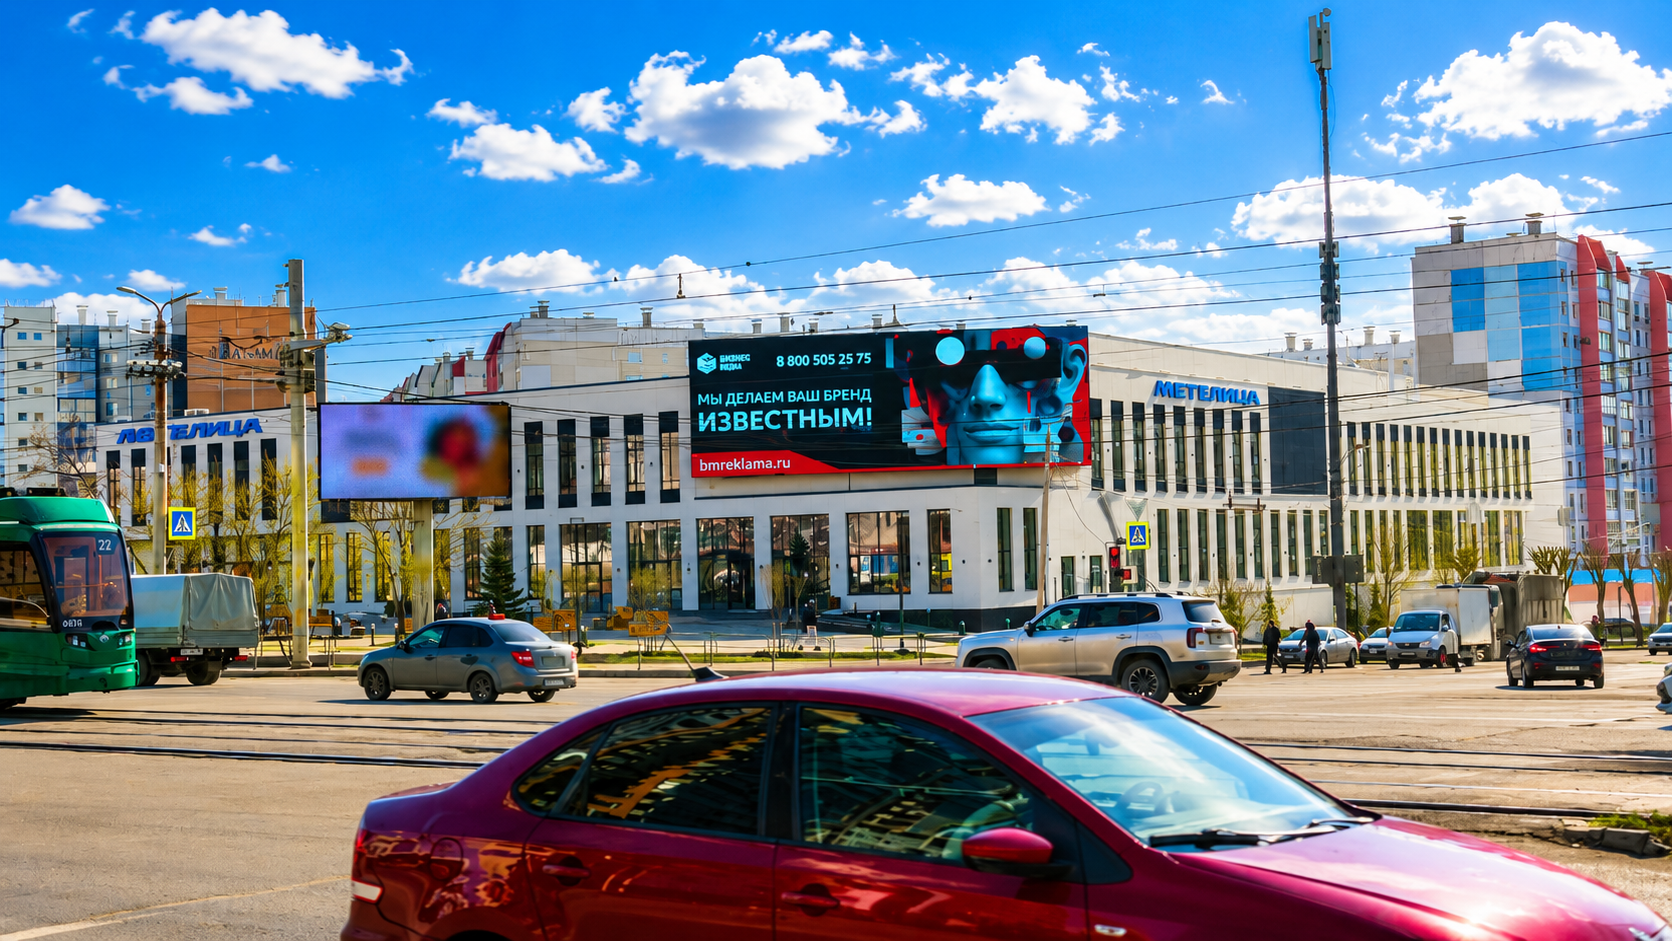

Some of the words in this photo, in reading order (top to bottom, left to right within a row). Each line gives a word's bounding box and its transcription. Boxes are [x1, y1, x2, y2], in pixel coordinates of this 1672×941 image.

[776, 355, 784, 368] 8
[786, 354, 810, 367] 800
[812, 353, 836, 366] 505
[838, 352, 853, 365] 25
[856, 352, 872, 364] 75
[697, 393, 722, 406] МЫ
[725, 391, 784, 407] ДЕЛАЕМ
[787, 389, 820, 403] ВАШ
[823, 388, 872, 403] БРЕНД
[1153, 380, 1261, 405] МЕТЕЛИЦА
[697, 407, 872, 432] ИЗВЕСТНЫМ!
[699, 457, 791, 472] bmreklama.ru
[97, 539, 112, 551] 22
